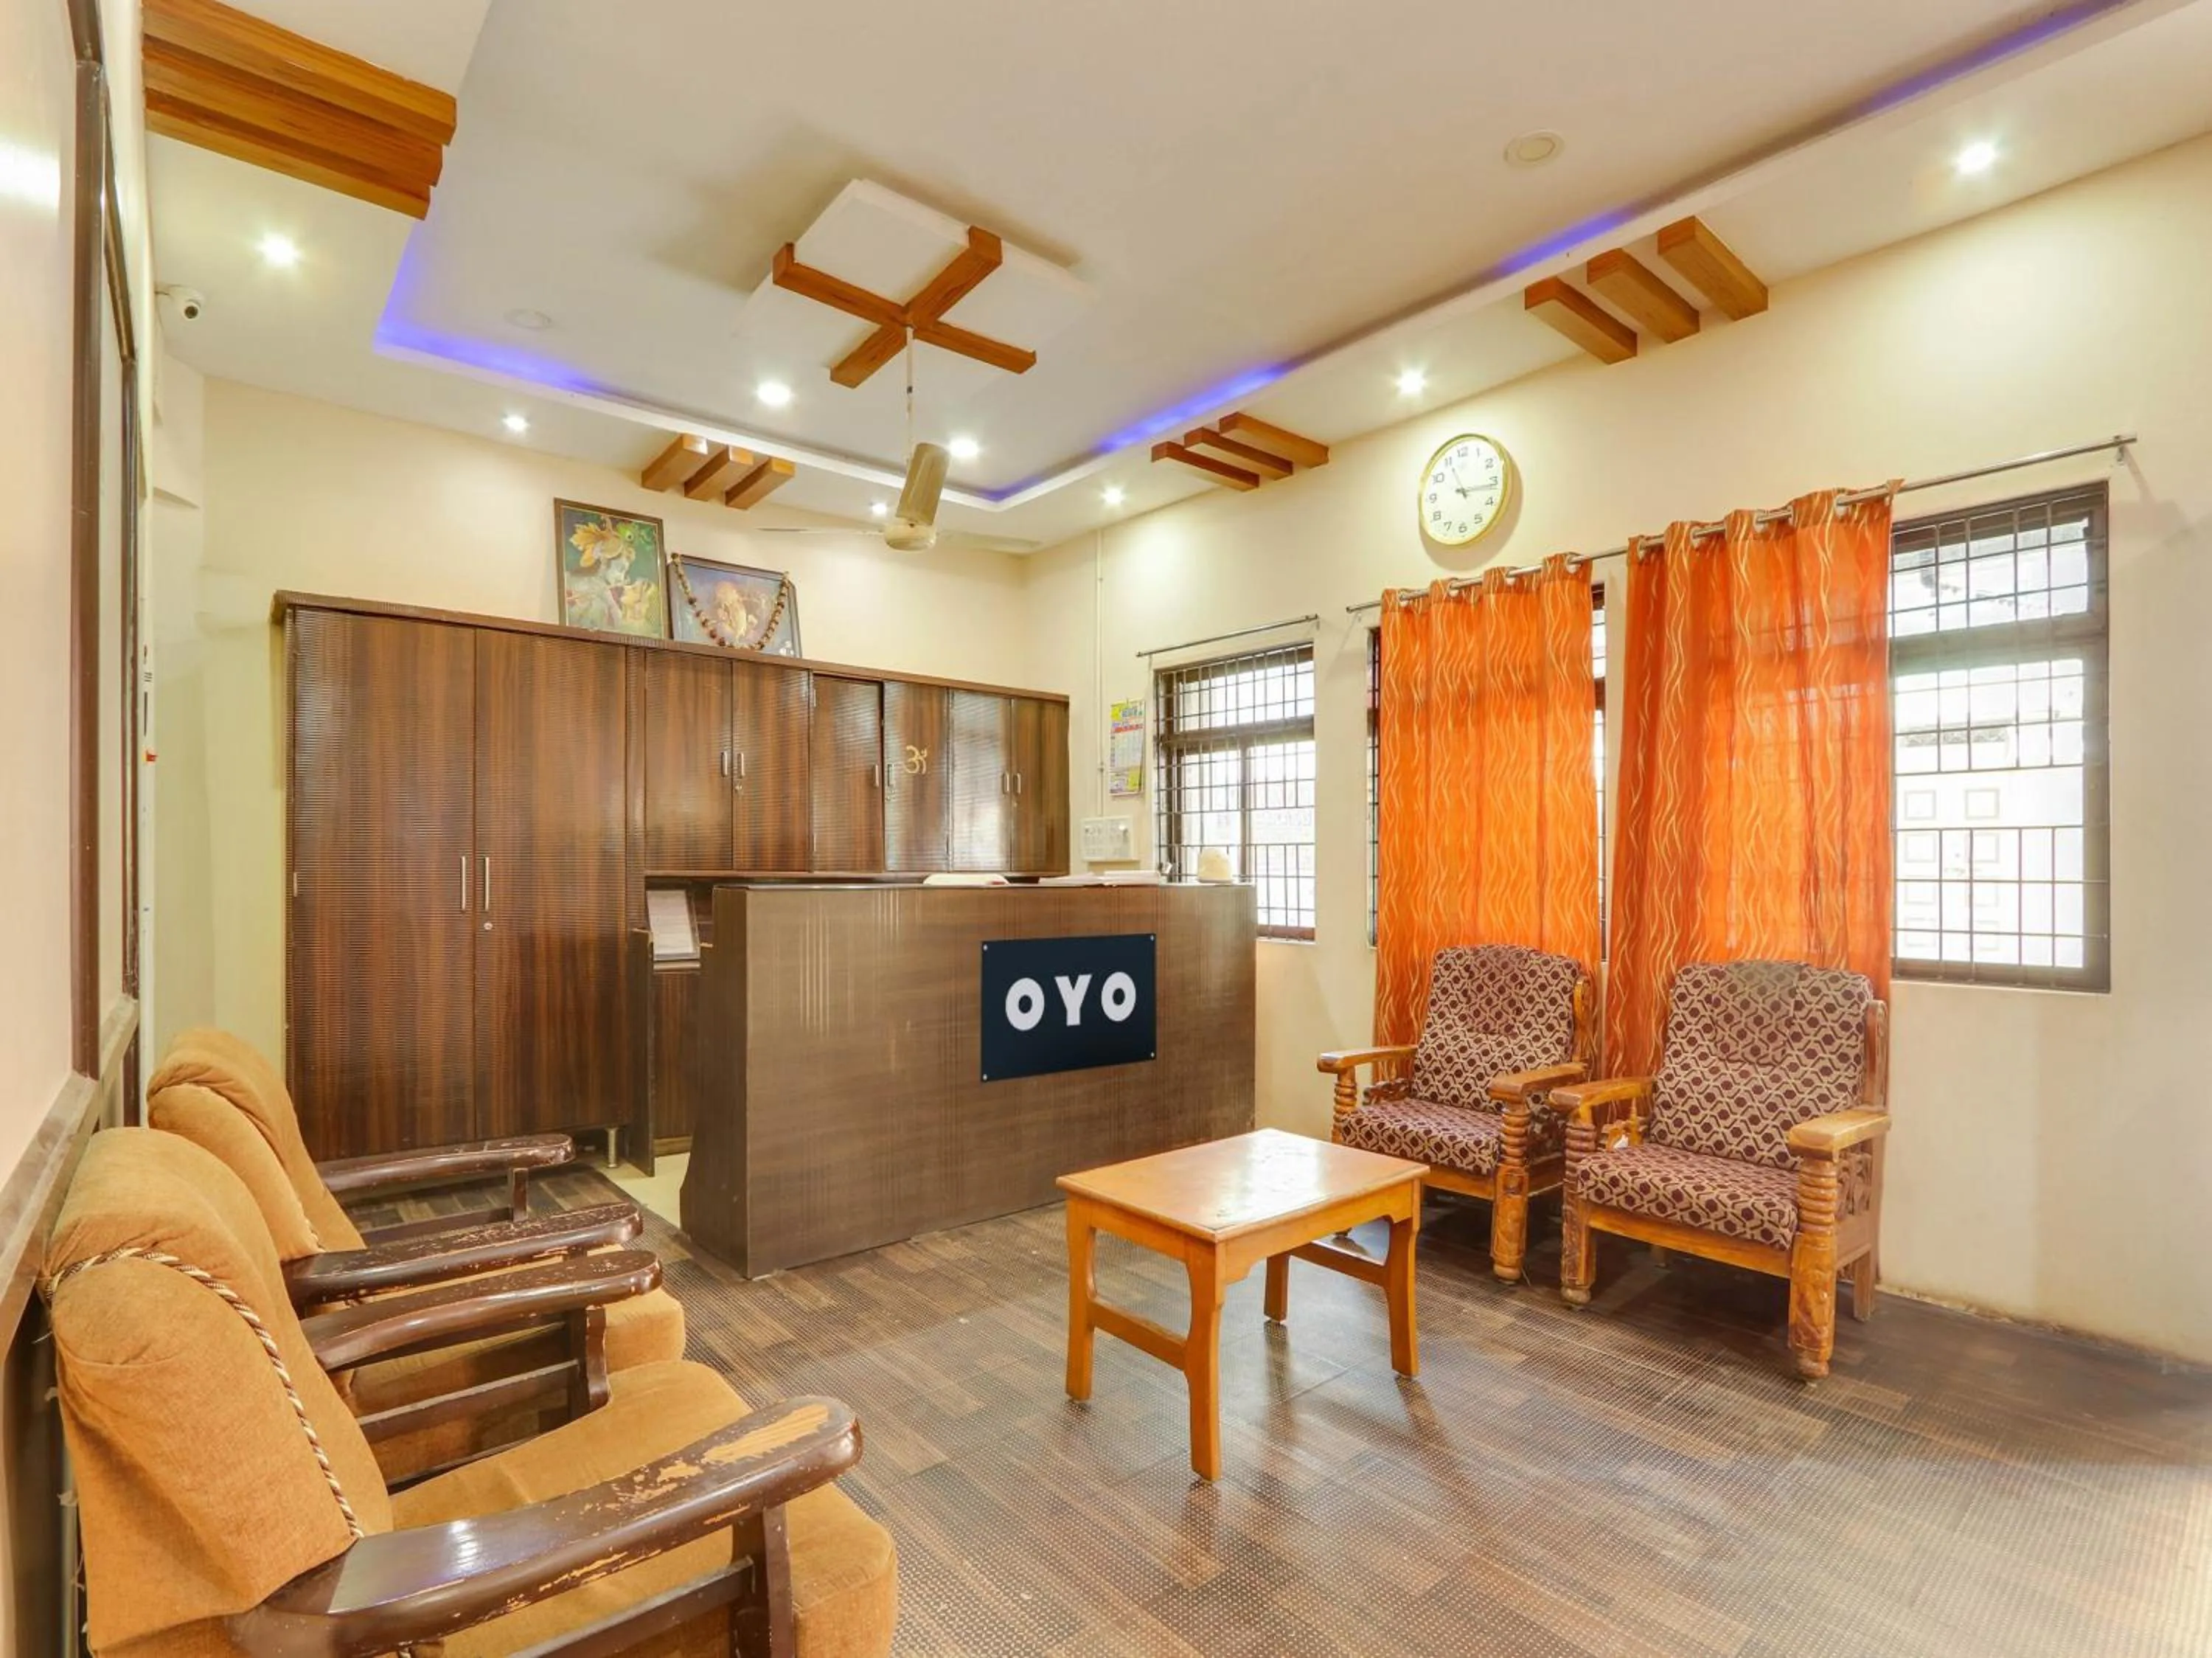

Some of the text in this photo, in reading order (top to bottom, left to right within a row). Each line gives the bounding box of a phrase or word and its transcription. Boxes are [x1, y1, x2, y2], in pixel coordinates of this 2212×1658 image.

[1457, 446, 1468, 457] 12
[1477, 448, 1480, 457] 1
[1444, 456, 1453, 468] 11
[1485, 458, 1494, 469] 2
[1433, 472, 1444, 484] 10
[1489, 476, 1498, 487] 3
[1429, 493, 1437, 503] 9
[1485, 497, 1494, 507] 4
[1433, 511, 1441, 521] 8
[1474, 513, 1483, 524] 5
[1444, 521, 1452, 531] 7
[1458, 523, 1467, 533] 6
[1005, 971, 1136, 1030] OYO
